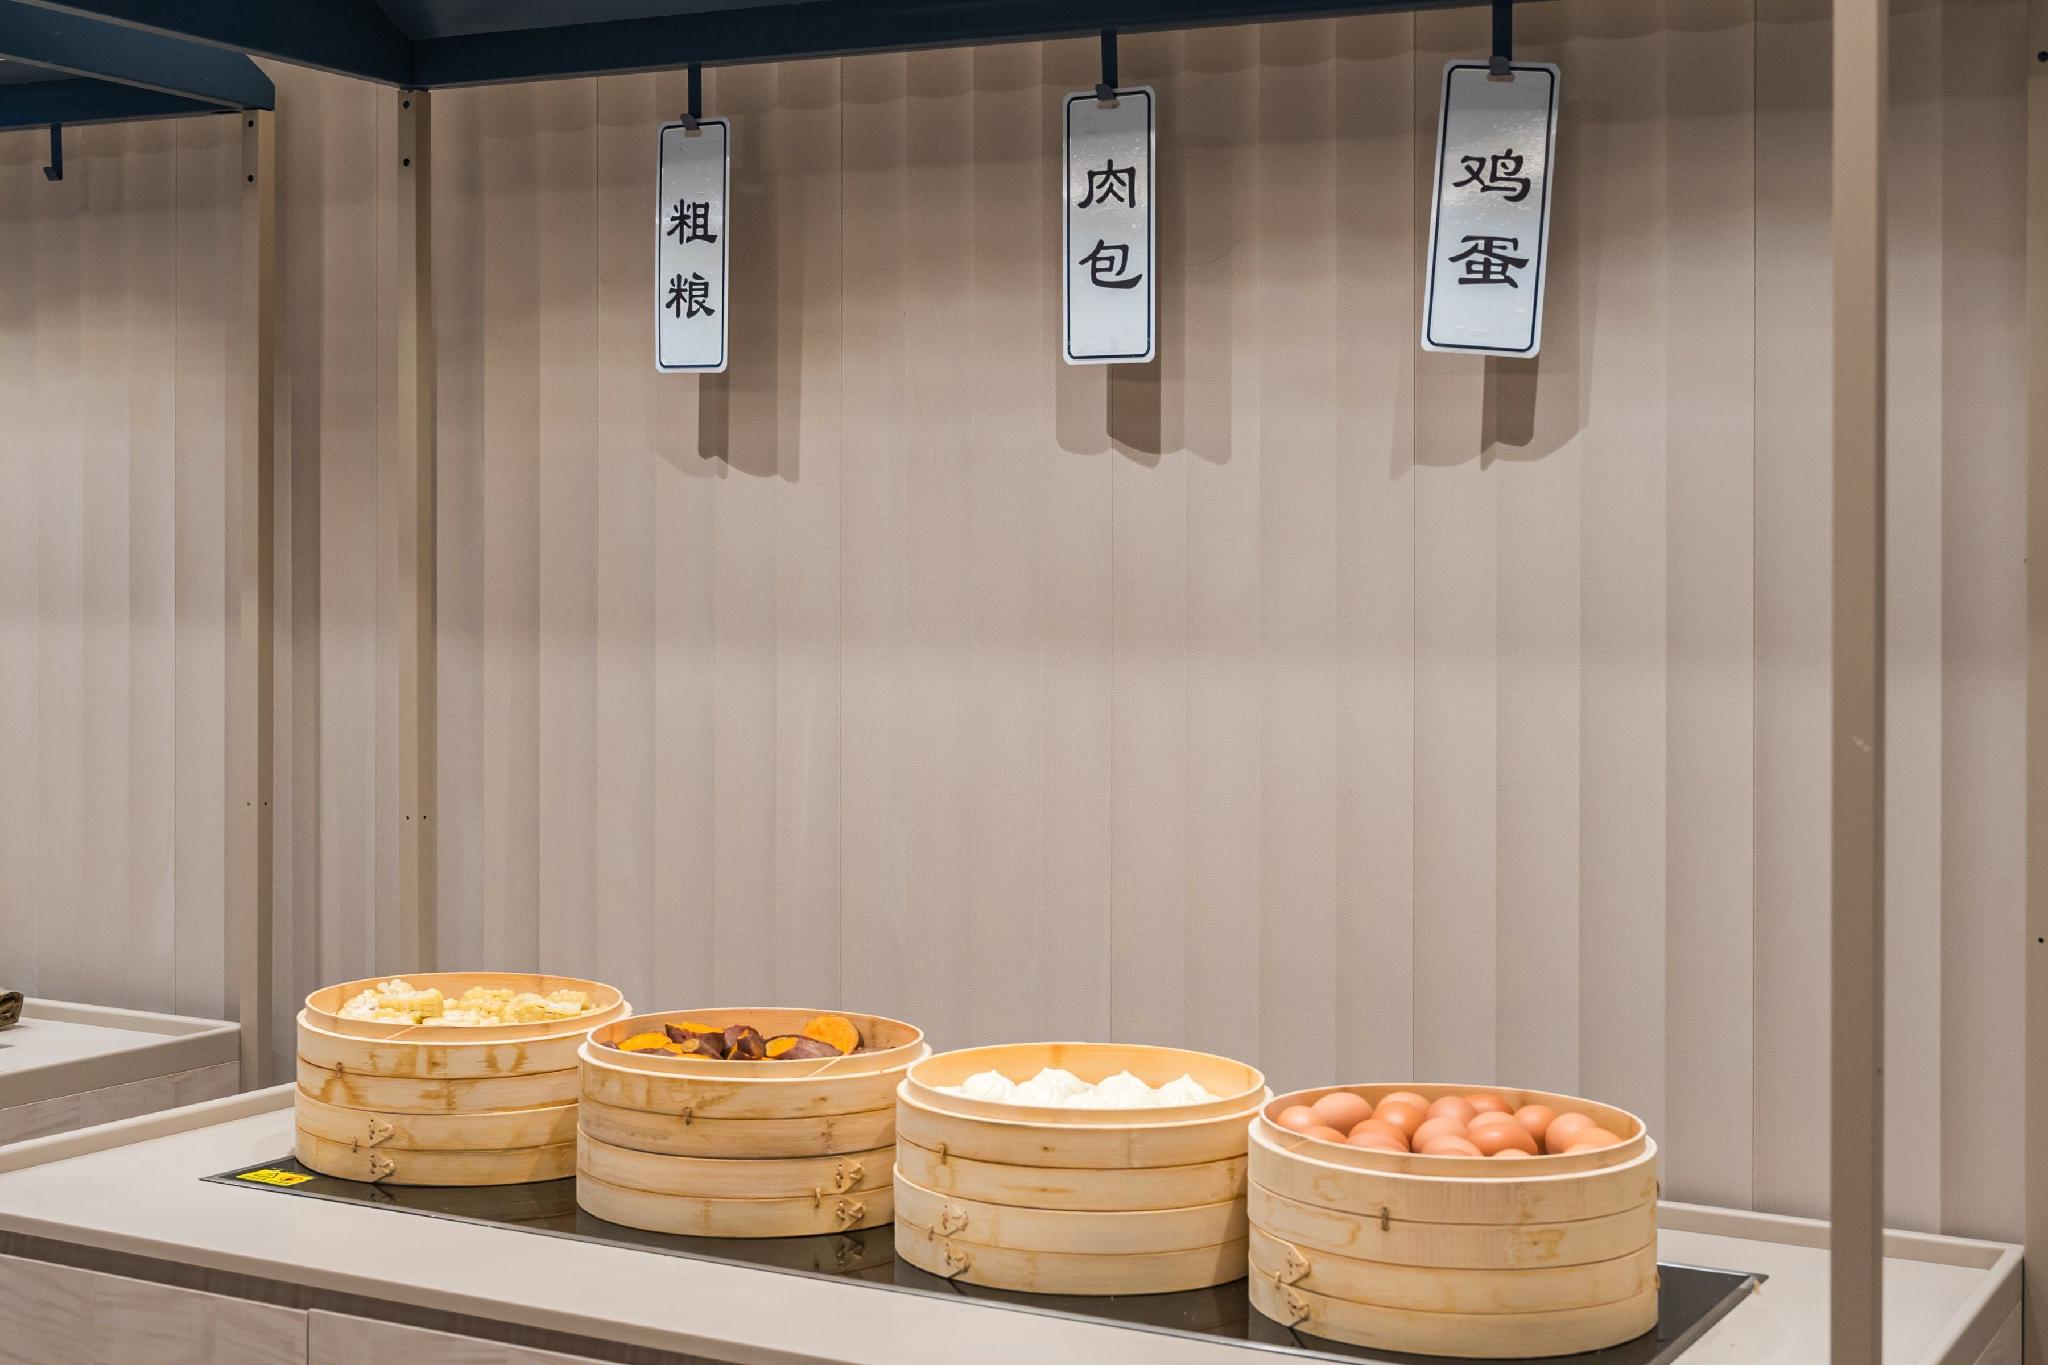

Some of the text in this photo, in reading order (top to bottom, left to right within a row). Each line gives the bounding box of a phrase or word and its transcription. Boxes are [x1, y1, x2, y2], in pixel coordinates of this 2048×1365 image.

[666, 198, 718, 319] 粗粮
[1077, 158, 1142, 289] 肉包
[1448, 147, 1531, 289] 鸡蛋
